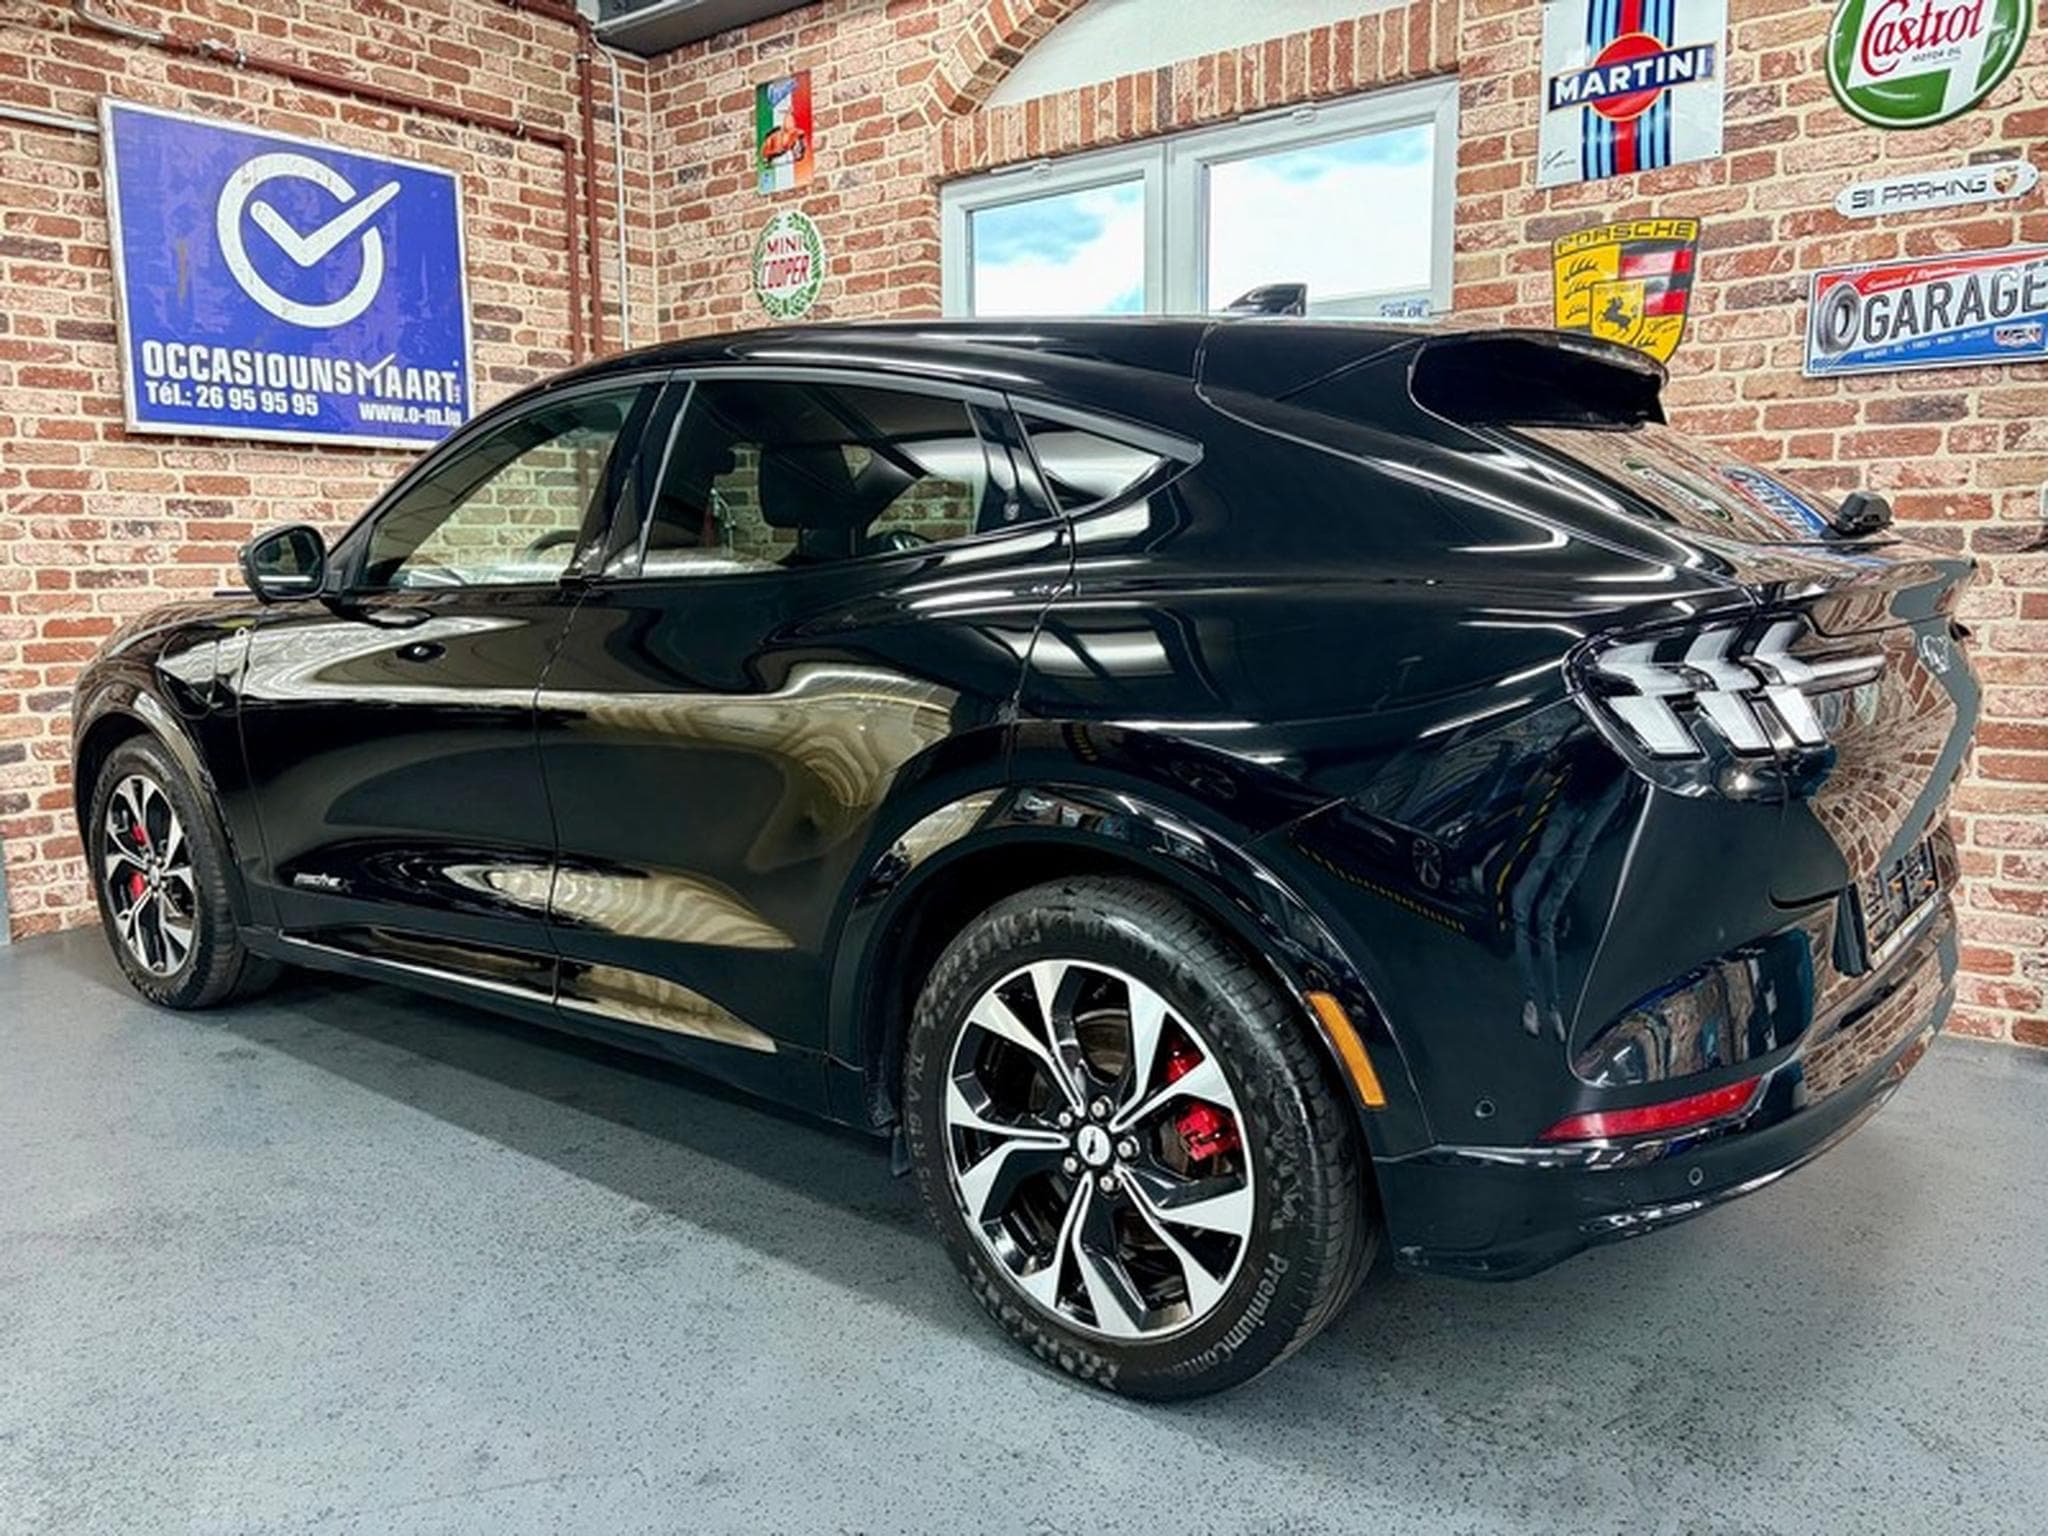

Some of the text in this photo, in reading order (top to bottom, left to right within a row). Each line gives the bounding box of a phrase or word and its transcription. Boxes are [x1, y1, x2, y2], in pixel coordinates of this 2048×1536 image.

[1861, 0, 1984, 77] Castrol
[1554, 49, 1707, 106] MARTINI
[1881, 173, 1987, 205] PARKING
[767, 235, 802, 256] MINI
[1557, 222, 1693, 255] PORSCHE
[761, 255, 810, 290] COOPER
[1862, 261, 2048, 345] GARAGE
[196, 386, 224, 410] 26
[228, 388, 257, 412] 95
[261, 391, 289, 415] 95
[293, 393, 320, 417] 95
[359, 402, 462, 428] www.o-m.lu
